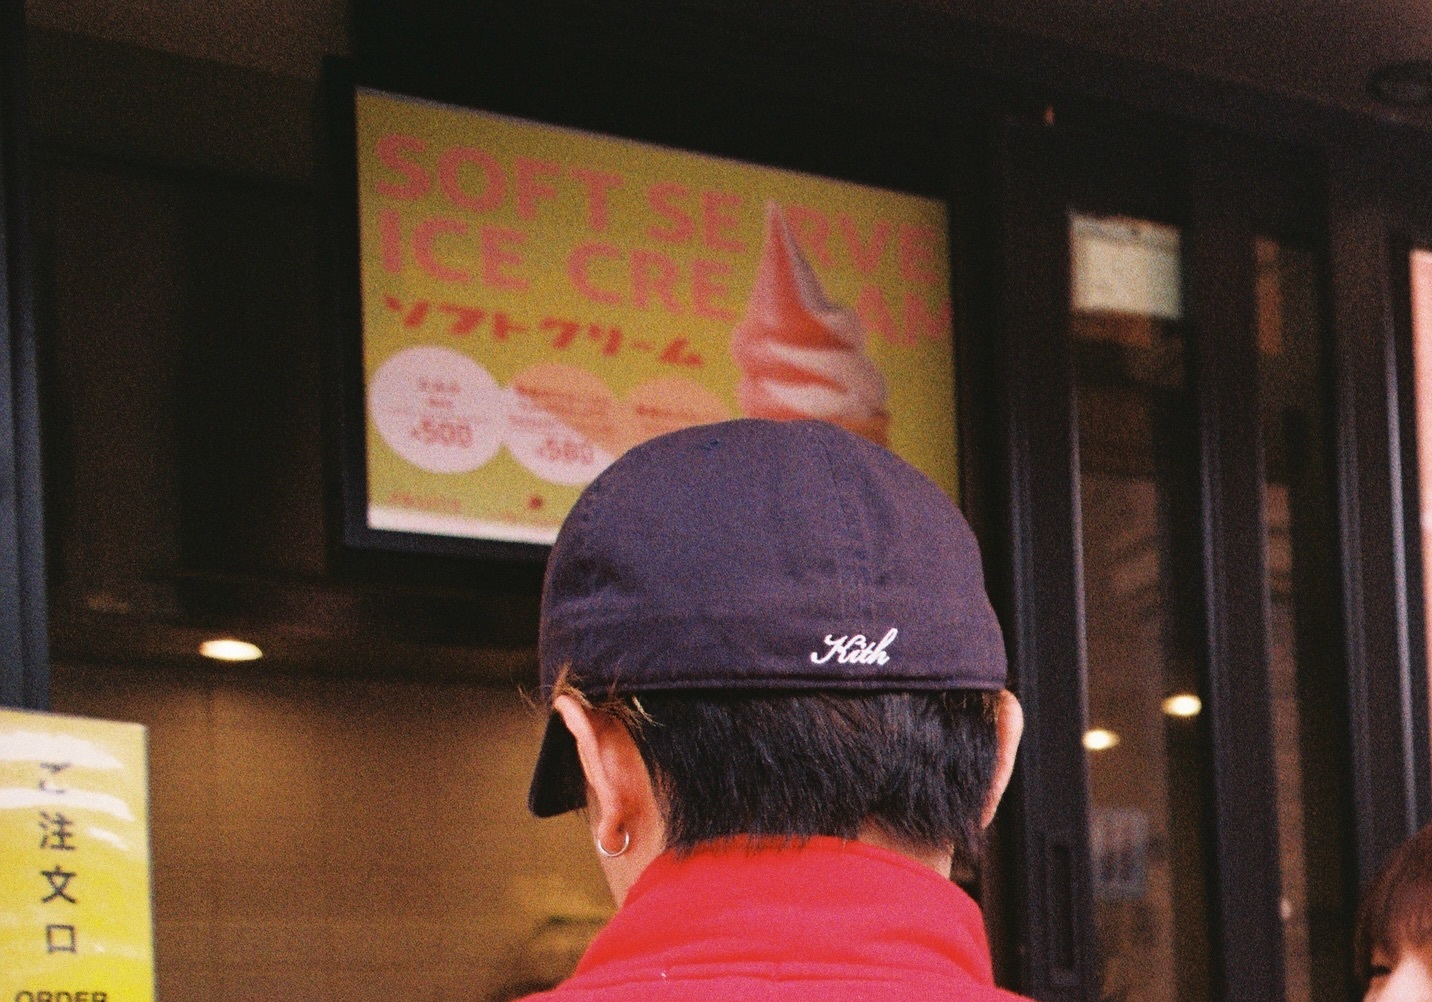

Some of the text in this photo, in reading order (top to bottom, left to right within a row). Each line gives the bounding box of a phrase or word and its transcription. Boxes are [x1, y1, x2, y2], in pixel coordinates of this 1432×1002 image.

[375, 132, 943, 287] SOFT SERVE
[378, 206, 954, 348] ICE CREAM
[383, 295, 706, 368] ソフトクリーム
[810, 628, 898, 665] Kith
